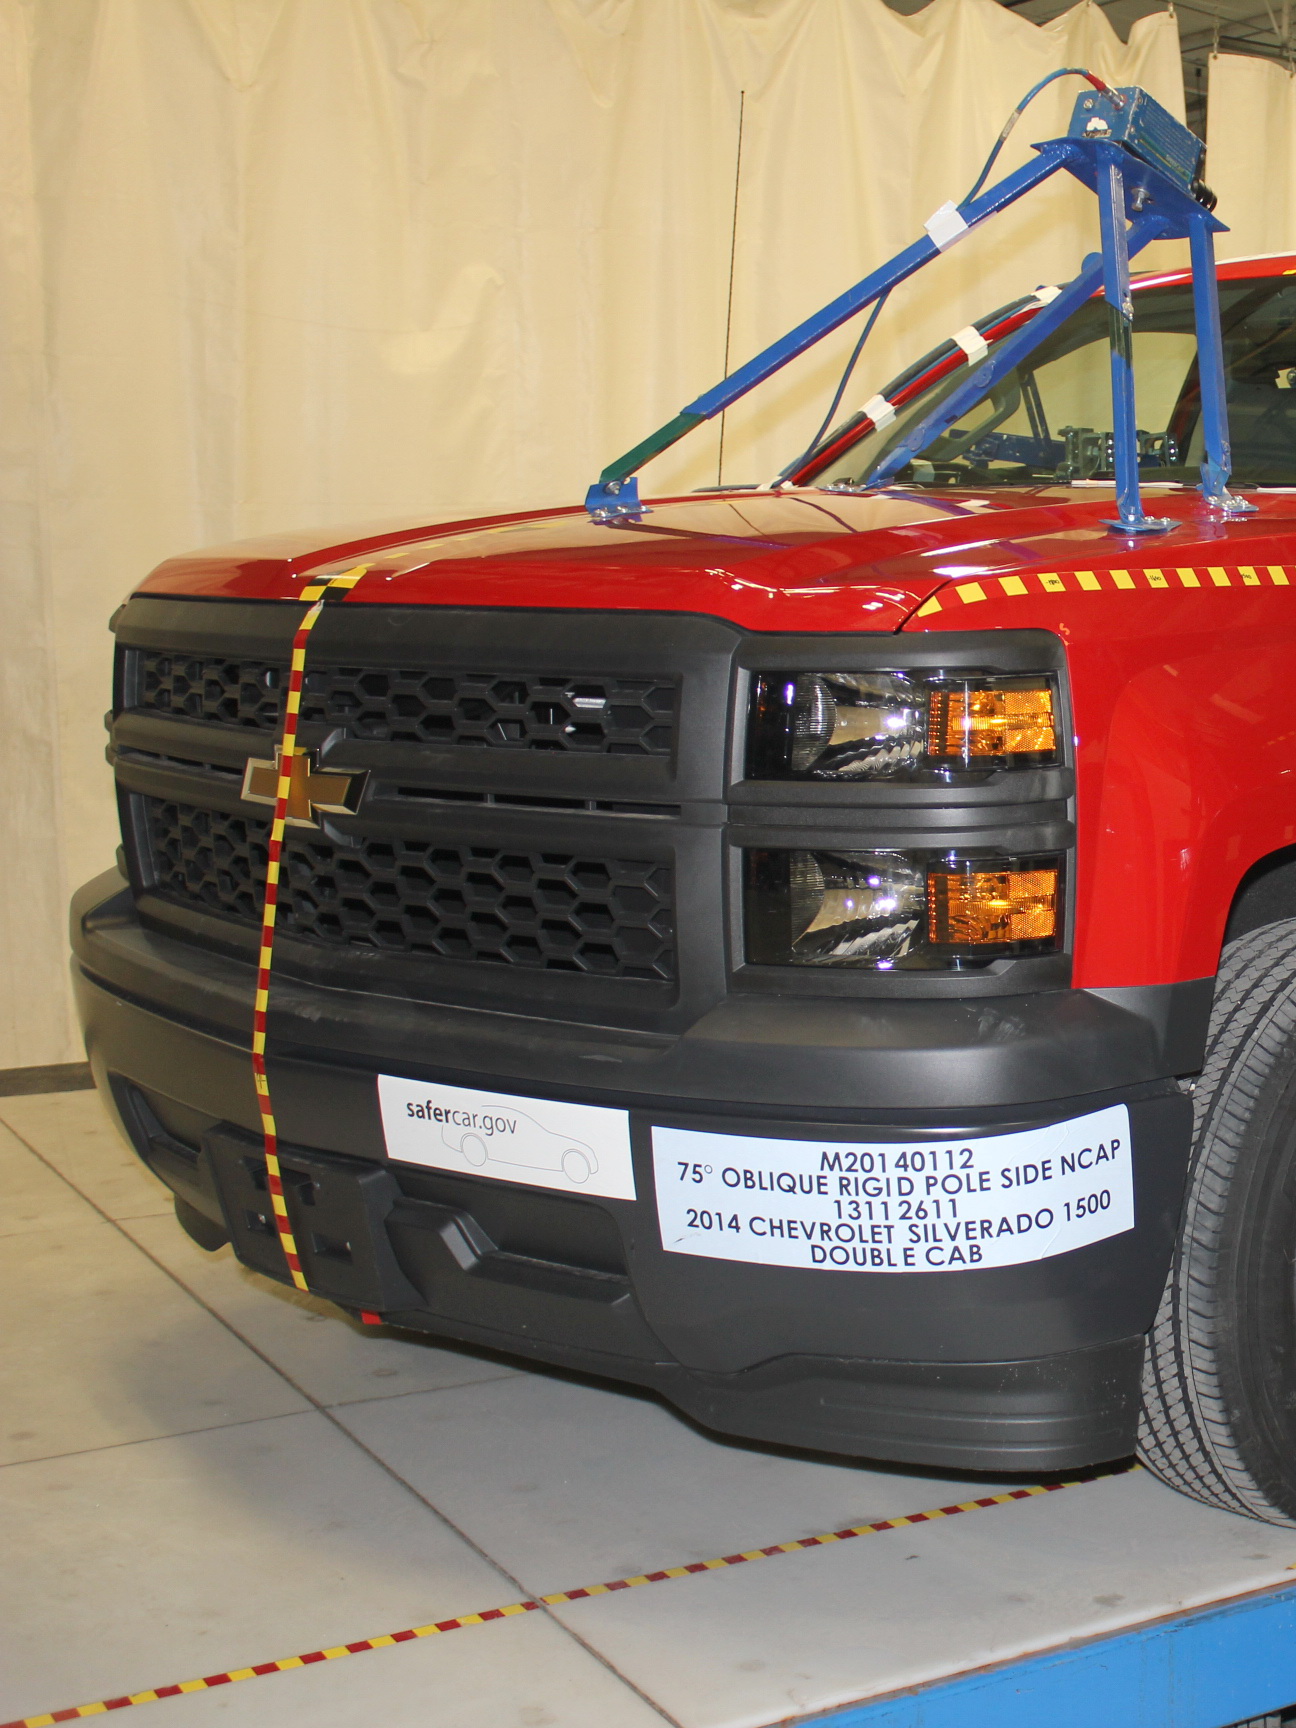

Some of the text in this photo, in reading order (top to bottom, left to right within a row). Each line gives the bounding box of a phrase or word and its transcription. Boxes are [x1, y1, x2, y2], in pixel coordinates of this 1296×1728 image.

[406, 1099, 517, 1137] safercar.gov
[721, 1167, 829, 1197] OBLIQUE
[838, 1175, 916, 1198] RIGID
[925, 1171, 992, 1197] POLE
[1000, 1160, 1054, 1189] SIDE
[1060, 1138, 1122, 1177] NCAP
[820, 1147, 974, 1174] M20140112
[686, 1188, 1112, 1245] 2014 CHEVROLET SILVERADO 1500
[833, 1198, 959, 1222] 13112611
[810, 1244, 984, 1268] DOUBLE CAB
